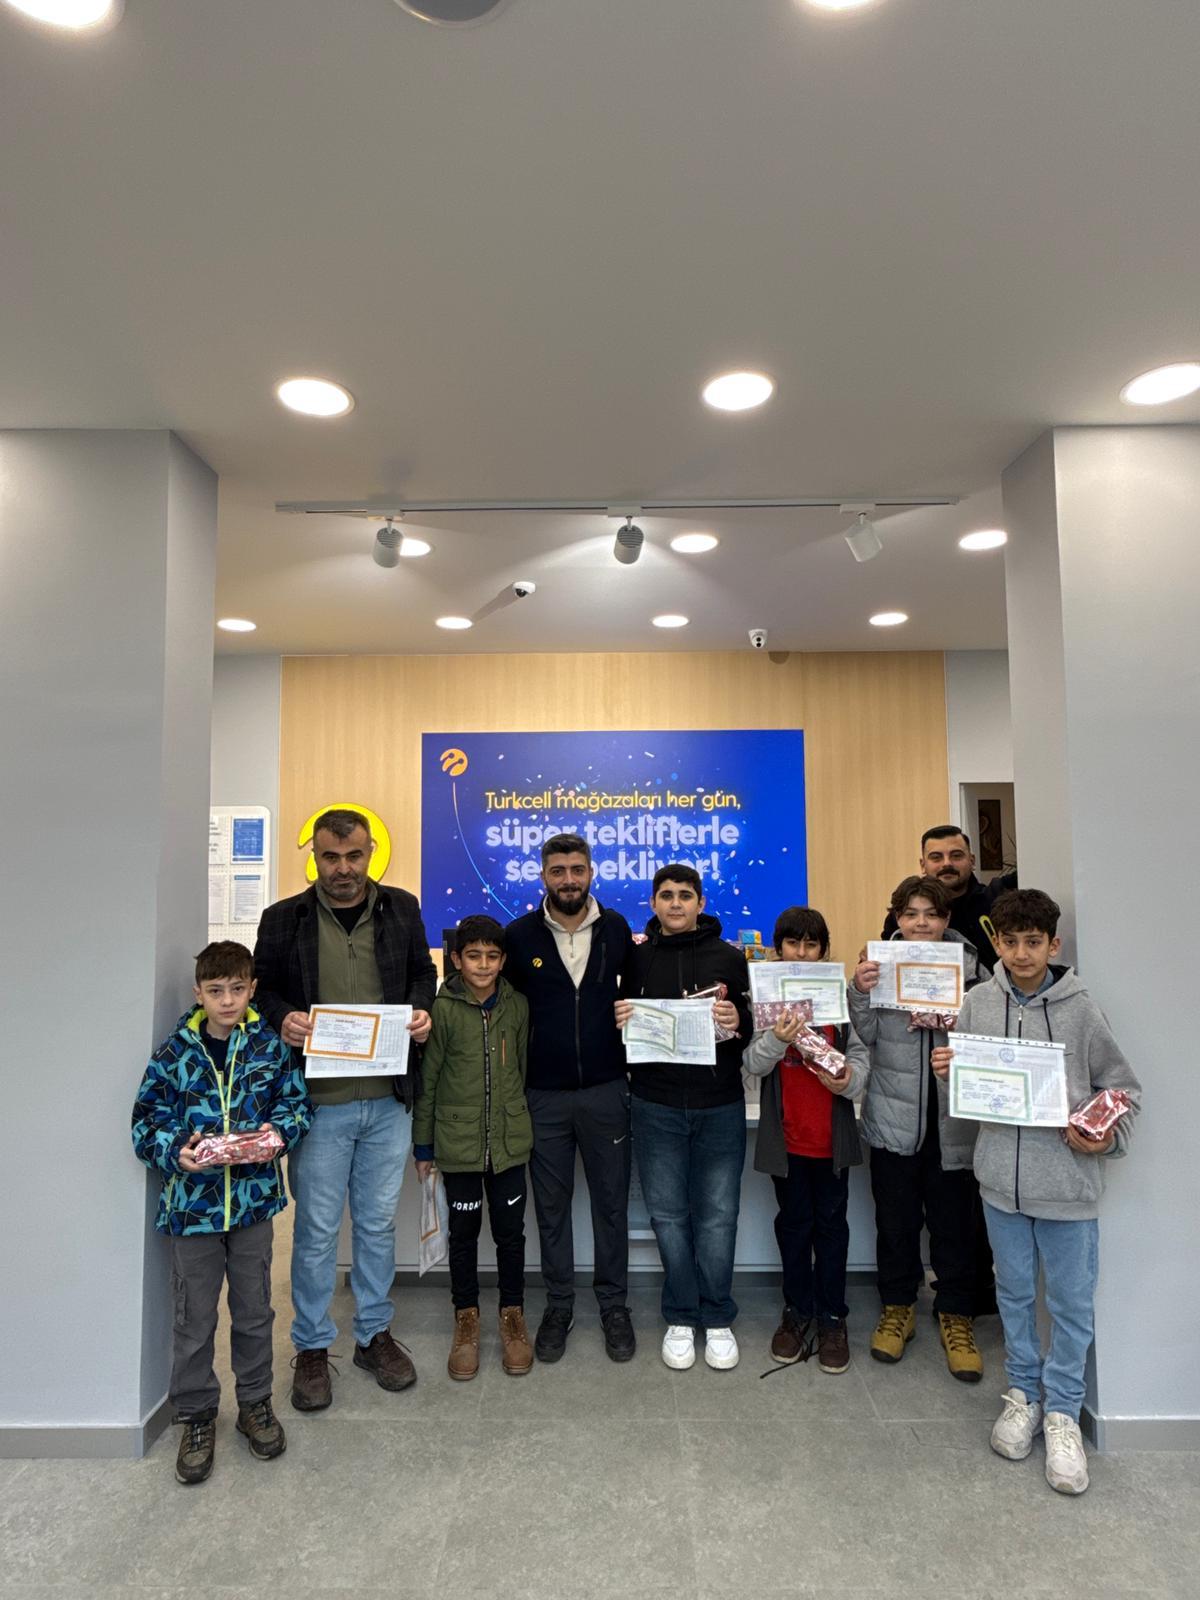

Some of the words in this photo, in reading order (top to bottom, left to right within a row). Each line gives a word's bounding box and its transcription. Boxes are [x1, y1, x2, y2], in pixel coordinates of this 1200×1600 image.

[485, 791, 552, 809] Turkcell
[556, 790, 662, 812] mağazaları
[666, 790, 697, 808] her
[702, 789, 741, 812] gün,
[584, 815, 740, 847] tekliflerle
